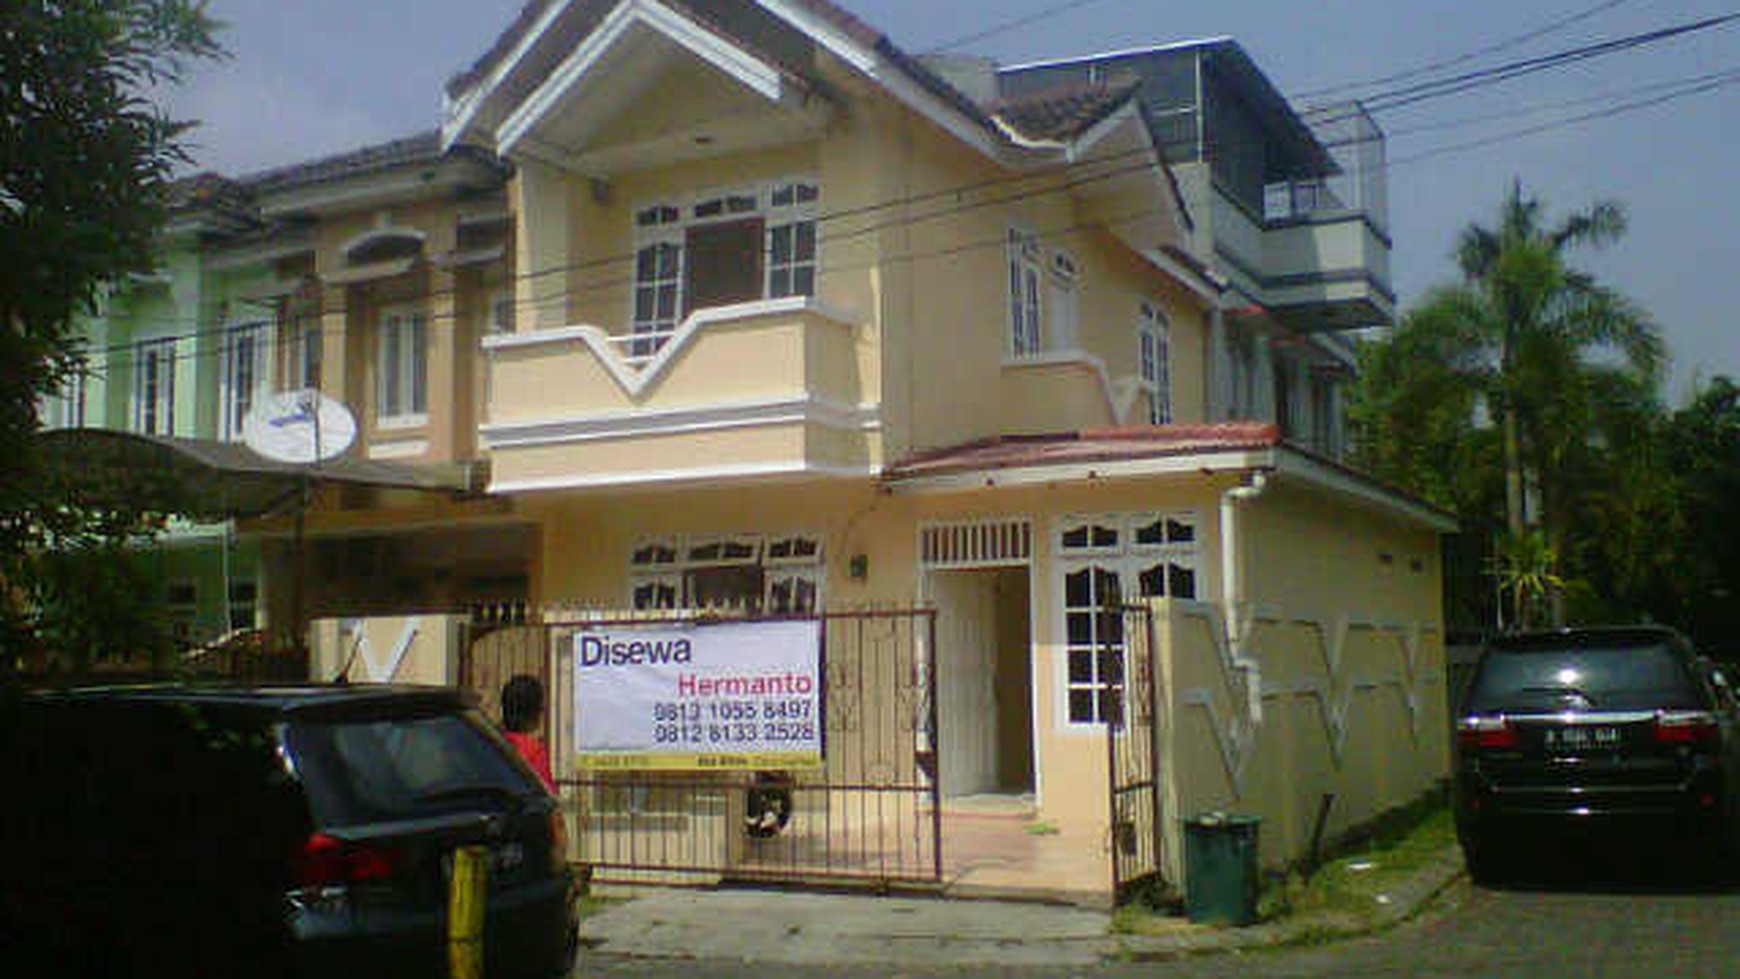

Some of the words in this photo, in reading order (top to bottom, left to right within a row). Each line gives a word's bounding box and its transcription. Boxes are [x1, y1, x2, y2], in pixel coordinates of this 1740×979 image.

[581, 636, 692, 667] Disewa
[678, 672, 812, 696] Hermanto
[711, 701, 757, 720] 1055
[763, 700, 811, 719] 8497
[654, 724, 702, 743] 0812
